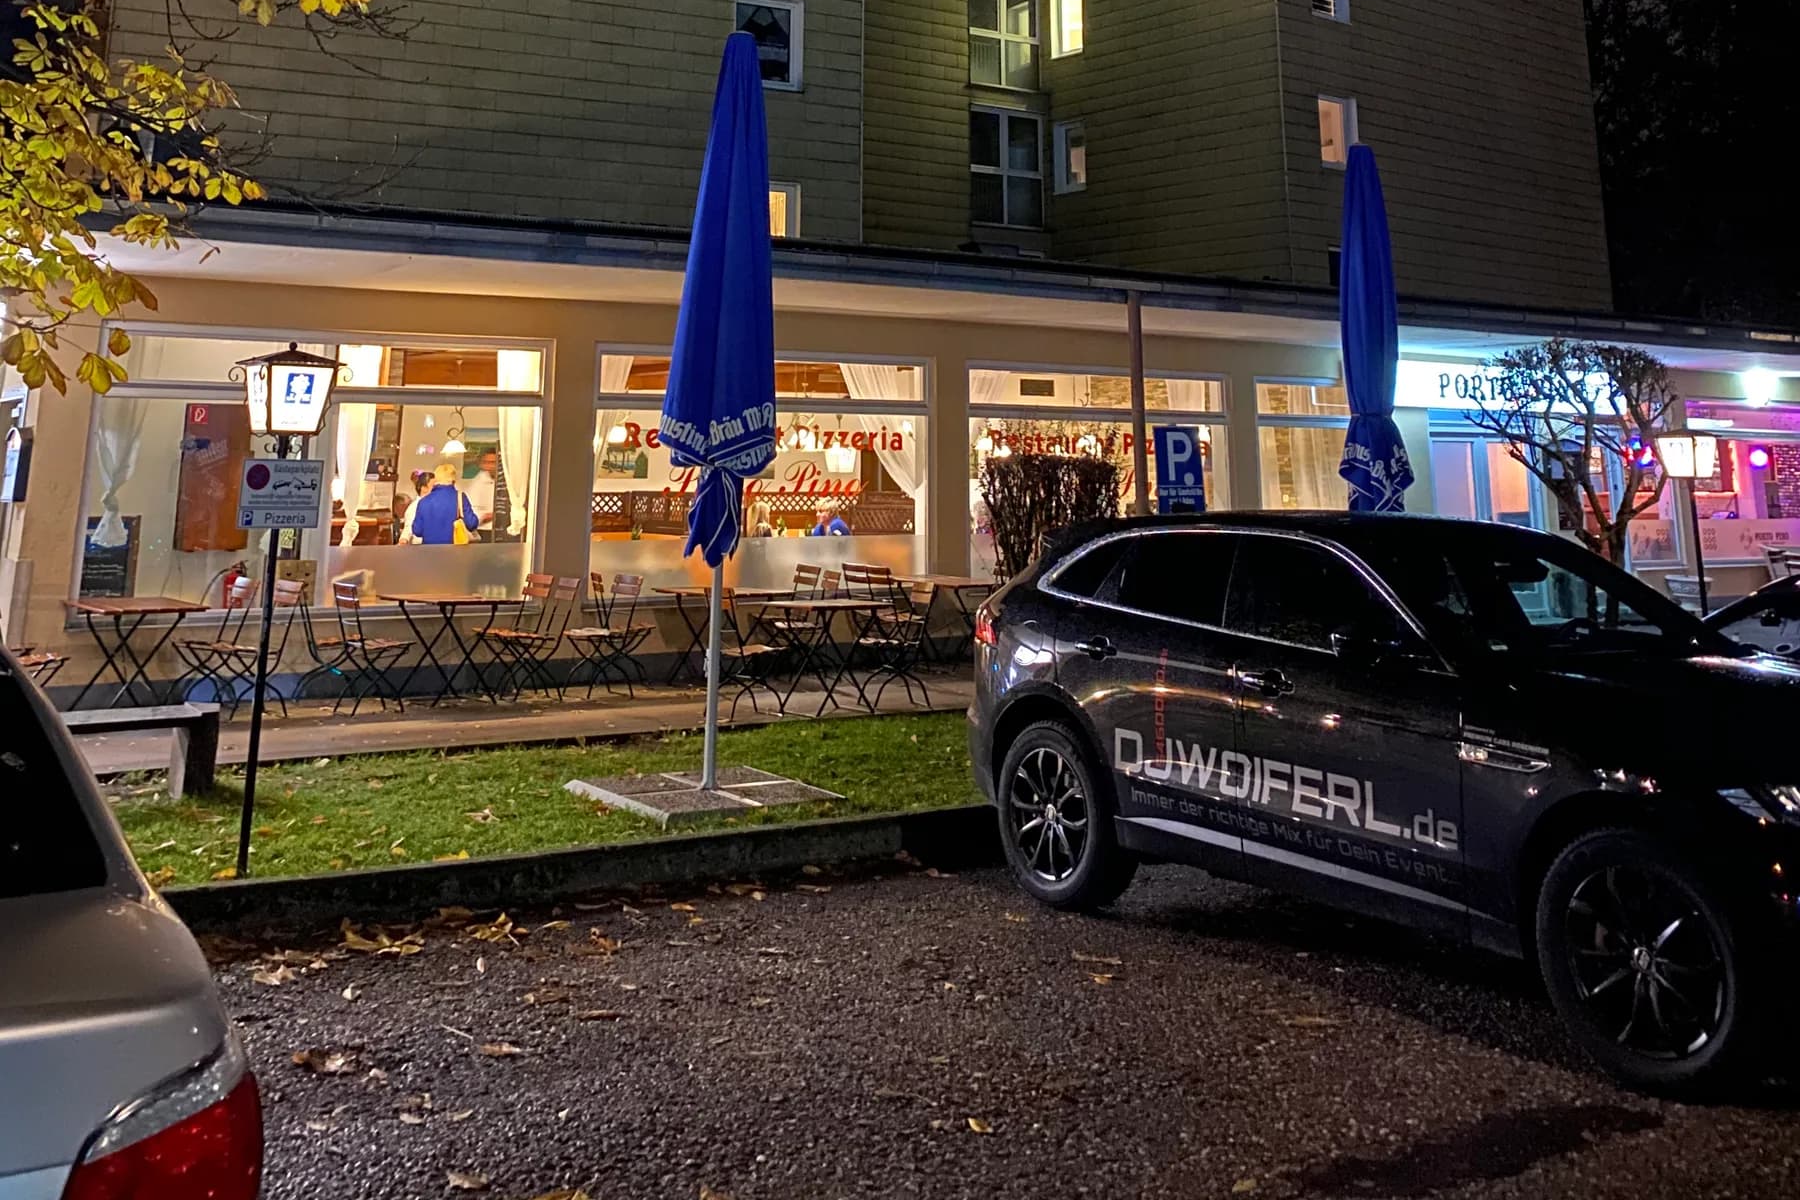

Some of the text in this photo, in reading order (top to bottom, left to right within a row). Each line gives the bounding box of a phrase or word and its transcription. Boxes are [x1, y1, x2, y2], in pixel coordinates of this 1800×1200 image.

[709, 416, 745, 446] Bräu
[796, 425, 904, 452] Pizzeria
[780, 460, 869, 498] Pino
[264, 512, 306, 524] Pizzeria
[1131, 786, 1175, 809] Immer
[1179, 799, 1205, 817] der
[1209, 806, 1270, 837] richtige
[1273, 821, 1302, 843] Mix
[1306, 829, 1333, 849] für
[1338, 839, 1382, 865] Dein
